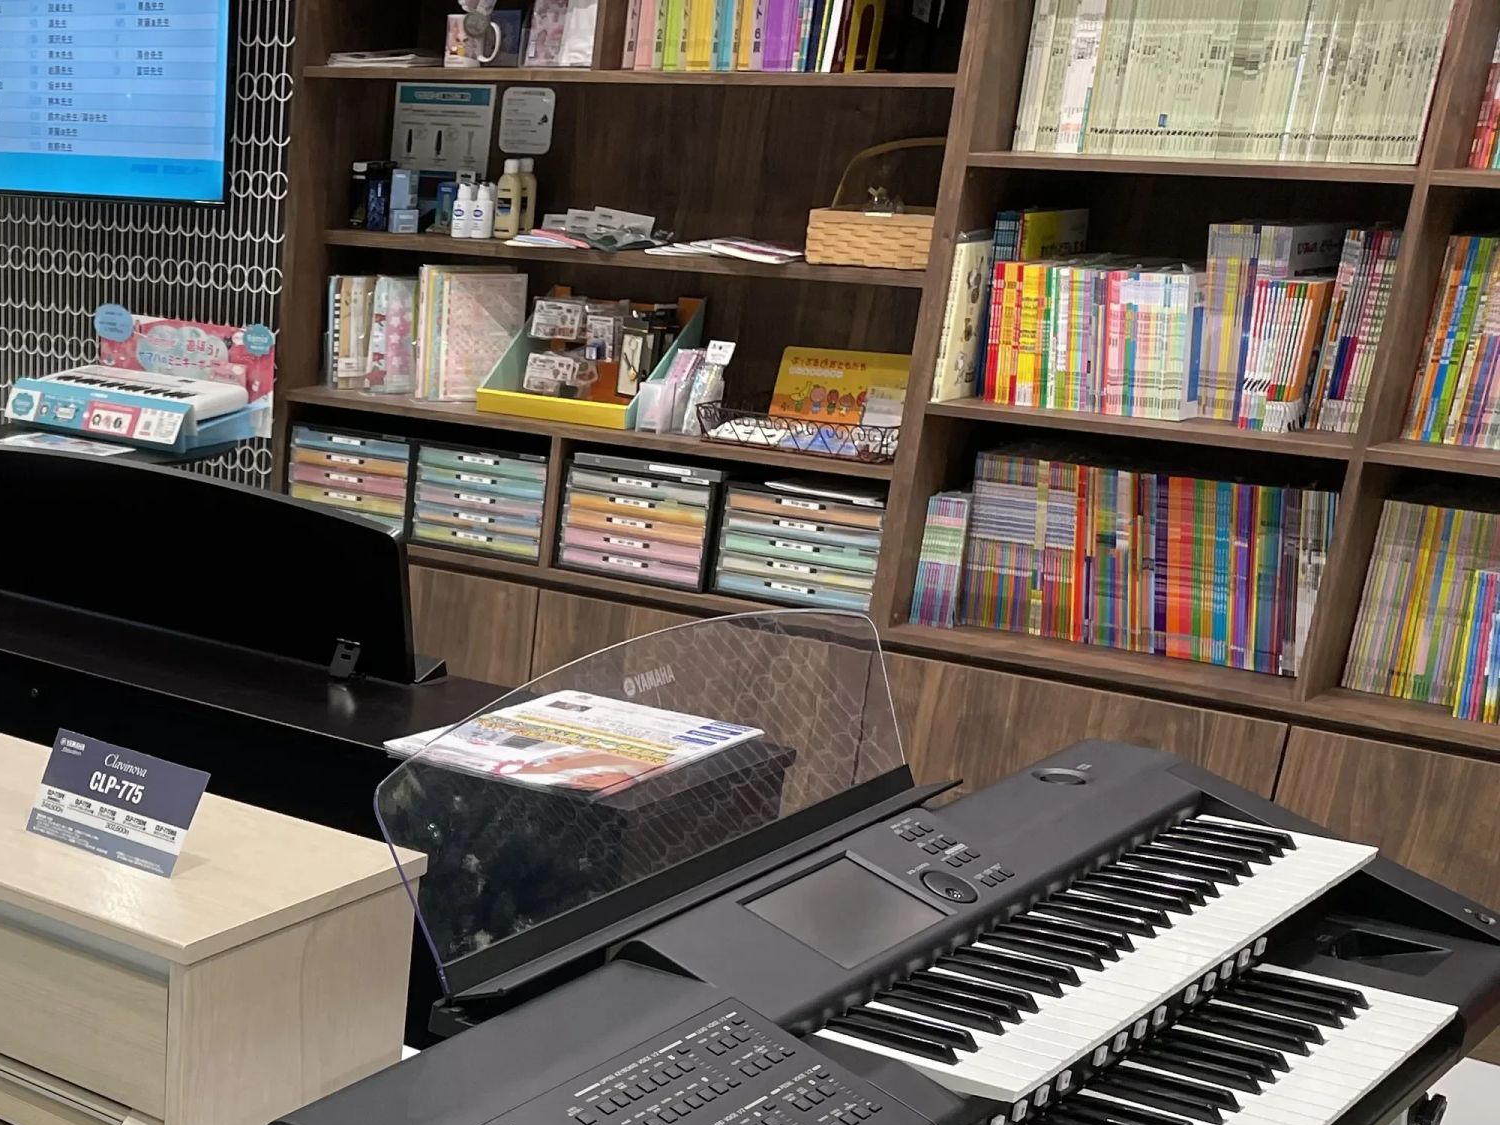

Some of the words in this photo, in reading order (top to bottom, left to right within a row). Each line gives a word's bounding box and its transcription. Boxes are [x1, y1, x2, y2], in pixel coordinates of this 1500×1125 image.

[632, 664, 676, 694] YAMAHA
[104, 753, 149, 778] Clavinova
[89, 771, 145, 804] CLP-775
